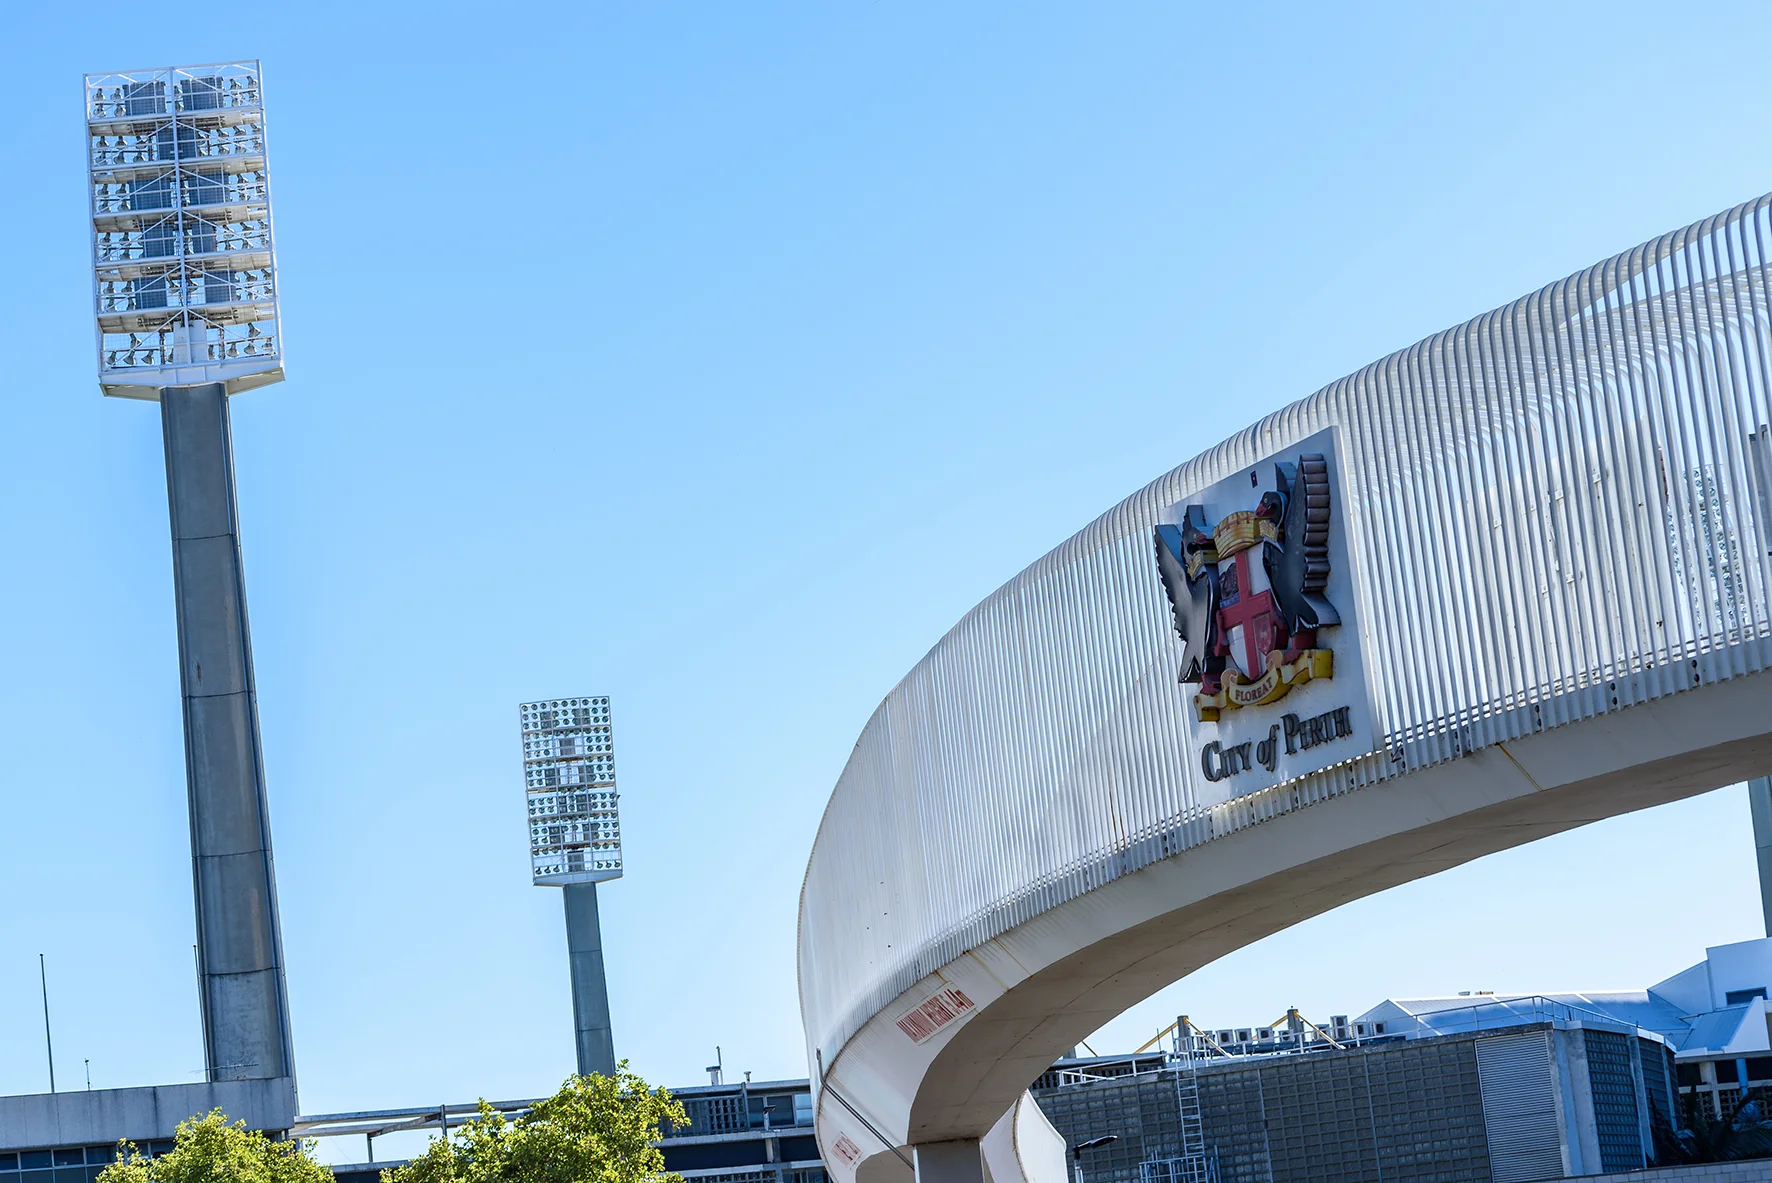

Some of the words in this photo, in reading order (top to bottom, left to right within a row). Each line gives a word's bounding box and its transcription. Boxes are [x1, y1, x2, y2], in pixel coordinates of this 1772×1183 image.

[1234, 677, 1273, 702] FLOREAT
[1201, 740, 1252, 782] CITY
[1256, 724, 1280, 772] of
[1280, 706, 1353, 755] PERTH
[919, 996, 956, 1027] HEIGHT
